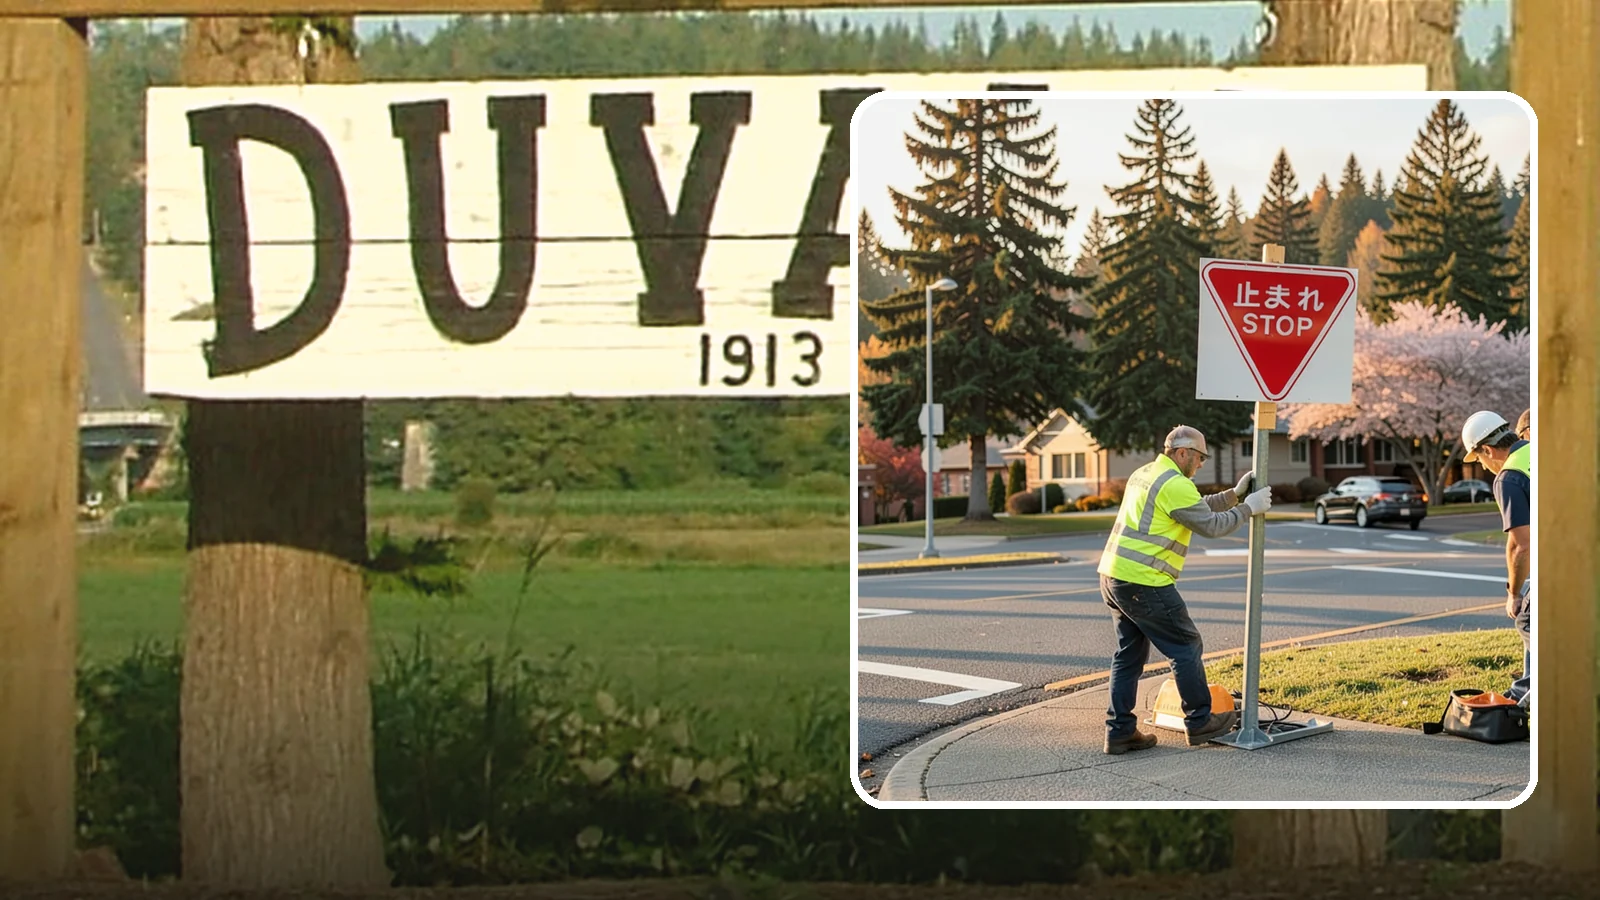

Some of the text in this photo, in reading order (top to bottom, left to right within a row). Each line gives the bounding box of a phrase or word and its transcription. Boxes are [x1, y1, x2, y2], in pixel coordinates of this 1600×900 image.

[186, 87, 885, 378] DUVA
[1233, 281, 1324, 312] 止まれ
[1242, 312, 1313, 337] STOP
[700, 331, 823, 387] 1913
